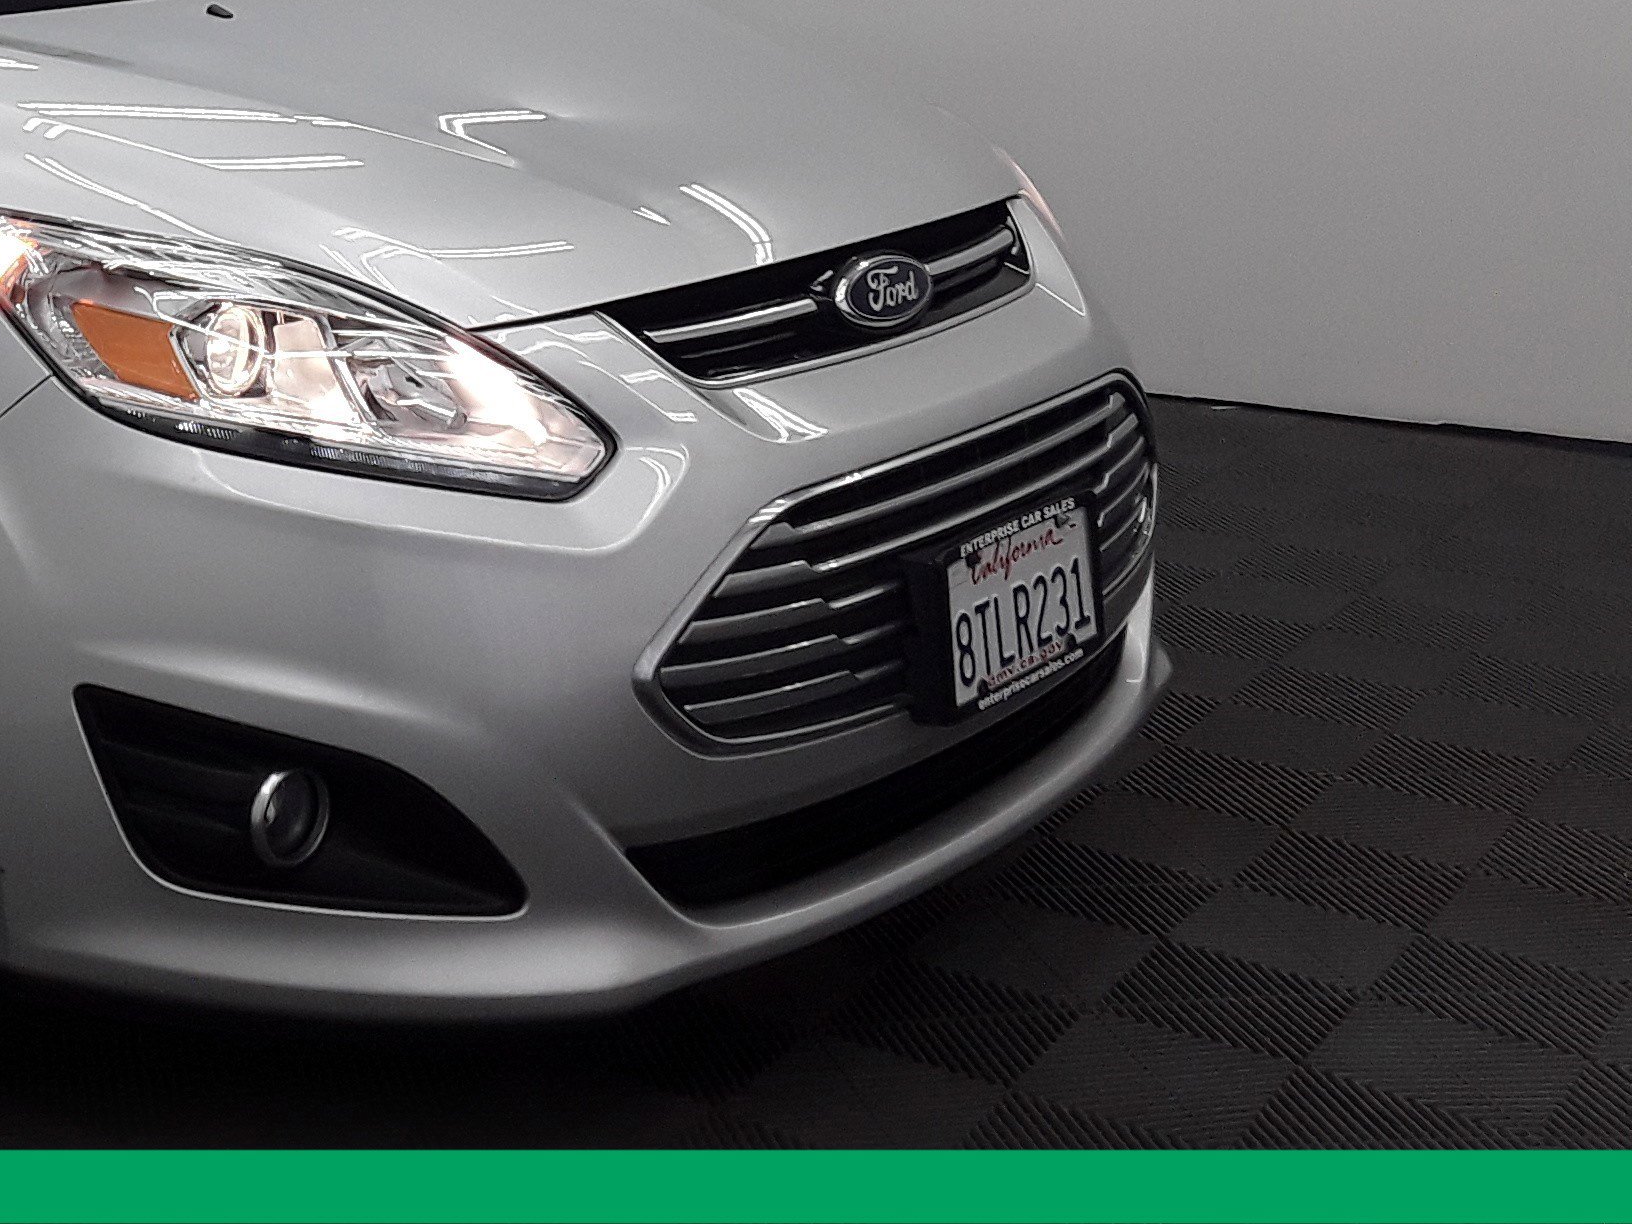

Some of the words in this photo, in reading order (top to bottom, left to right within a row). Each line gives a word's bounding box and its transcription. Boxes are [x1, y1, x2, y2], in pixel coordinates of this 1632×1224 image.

[867, 265, 918, 312] Ford
[960, 519, 1020, 558] ENTERPRISE
[1021, 510, 1043, 529] CAR
[1042, 497, 1076, 520] SALES
[955, 557, 1091, 688] 8TLR231
